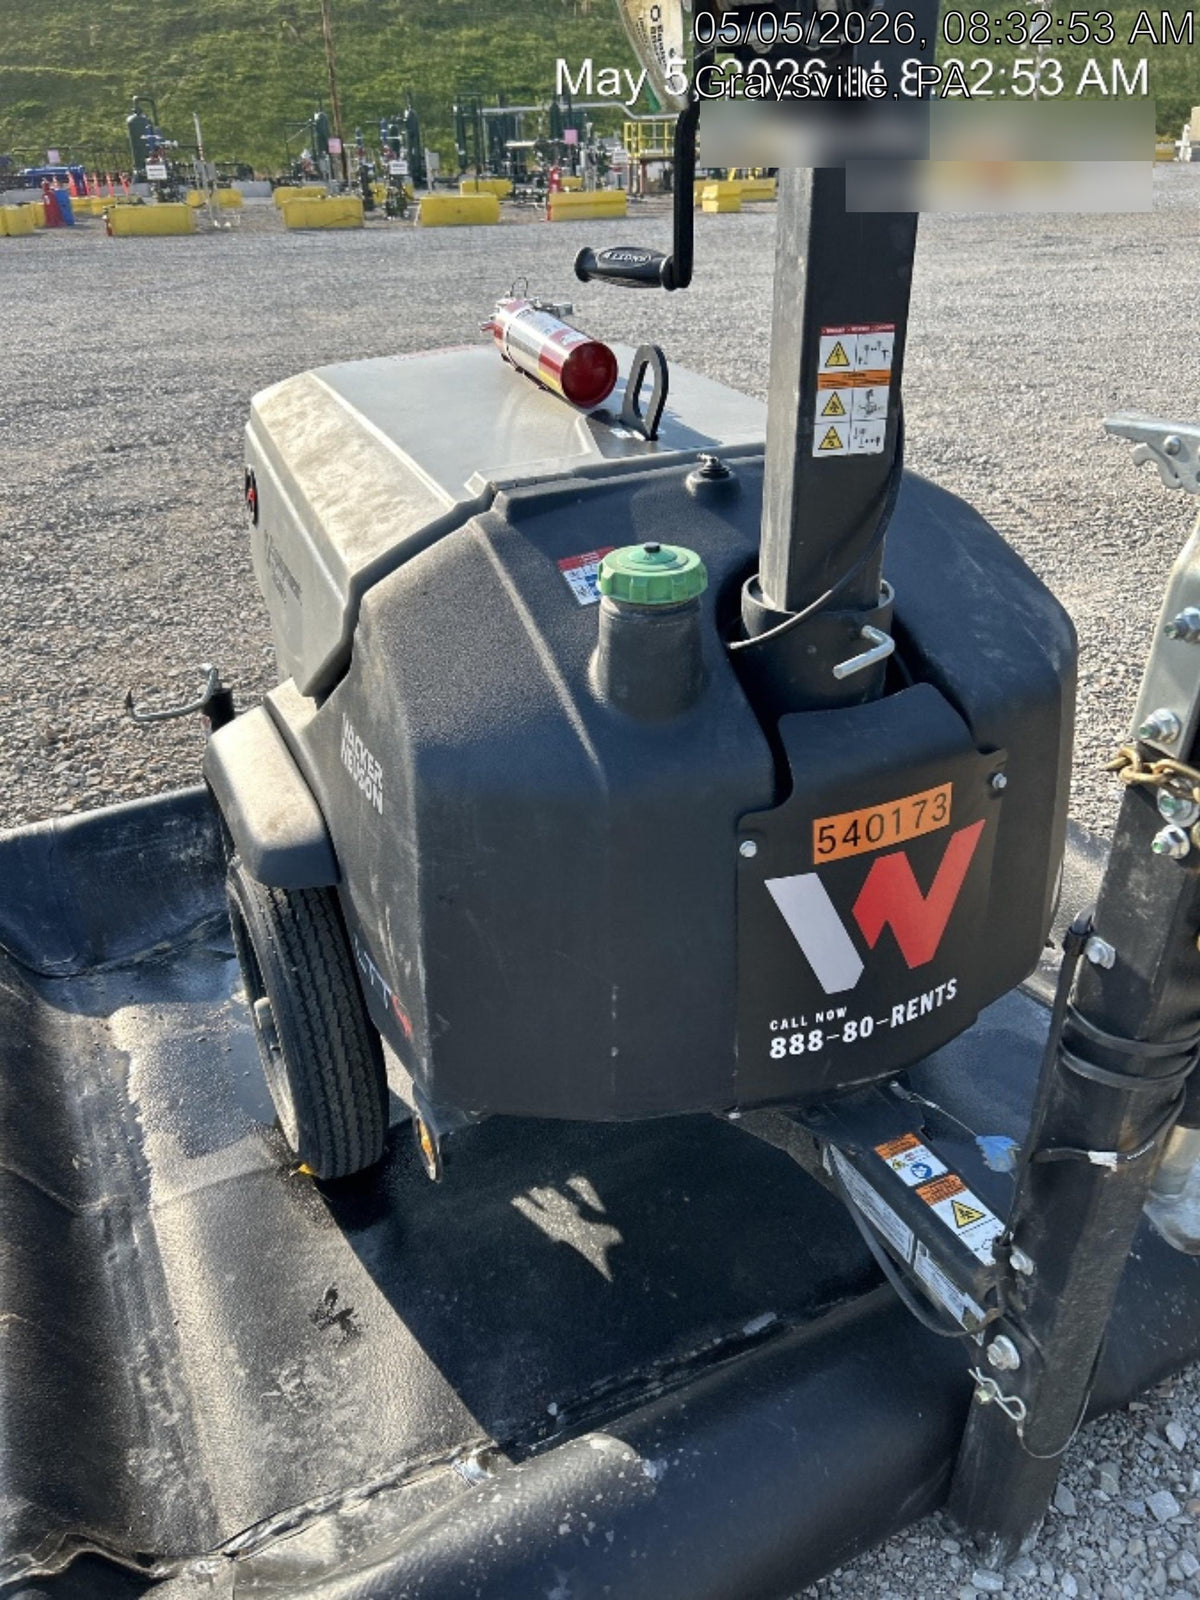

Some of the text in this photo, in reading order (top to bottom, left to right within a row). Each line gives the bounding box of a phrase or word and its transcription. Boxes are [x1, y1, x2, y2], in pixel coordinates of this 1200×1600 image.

[816, 792, 948, 855] 540173
[769, 1006, 848, 1031] CALL NOW
[769, 978, 958, 1060] 888-80-RENTS
